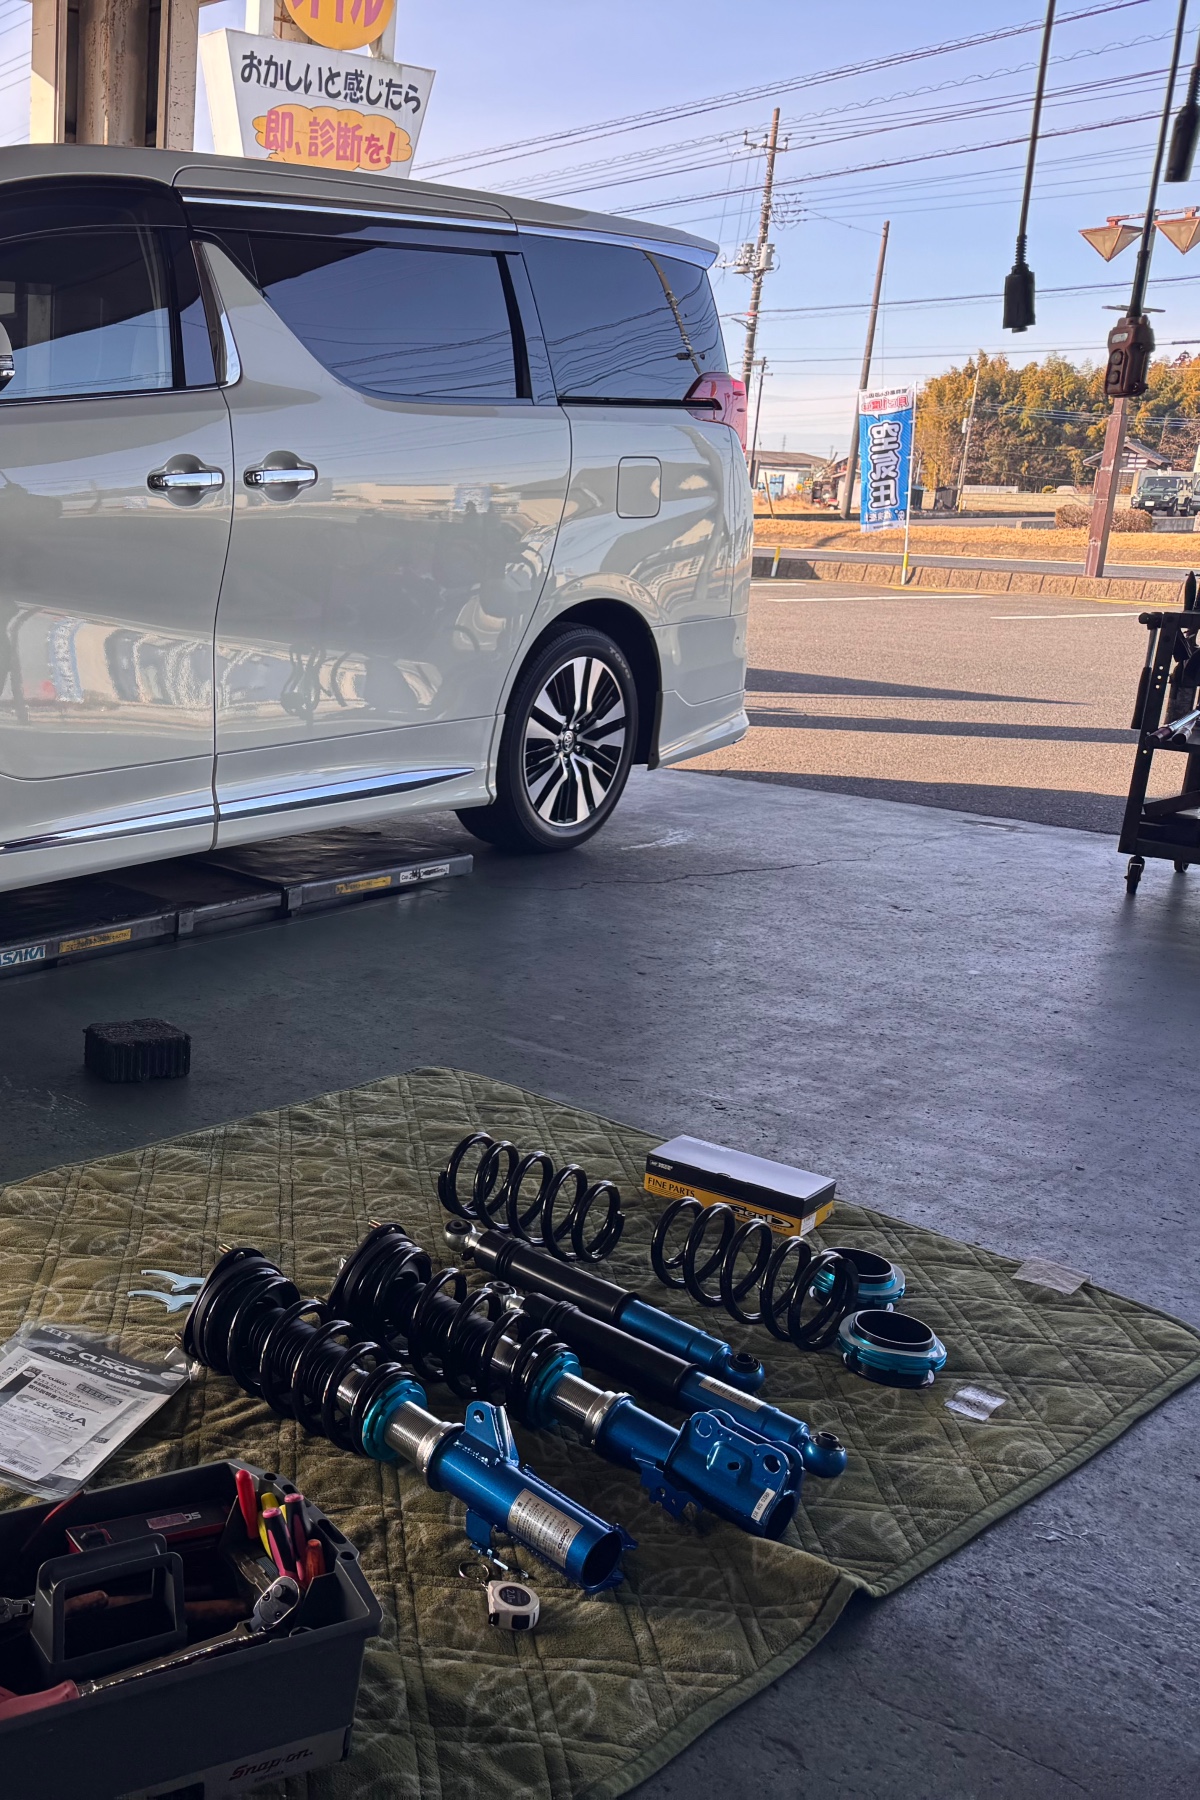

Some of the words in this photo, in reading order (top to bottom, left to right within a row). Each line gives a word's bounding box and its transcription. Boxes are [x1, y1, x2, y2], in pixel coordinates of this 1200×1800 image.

[240, 50, 422, 114] おかしいと感じたら
[647, 1176, 667, 1190] FINE
[668, 1181, 695, 1198] PARTS
